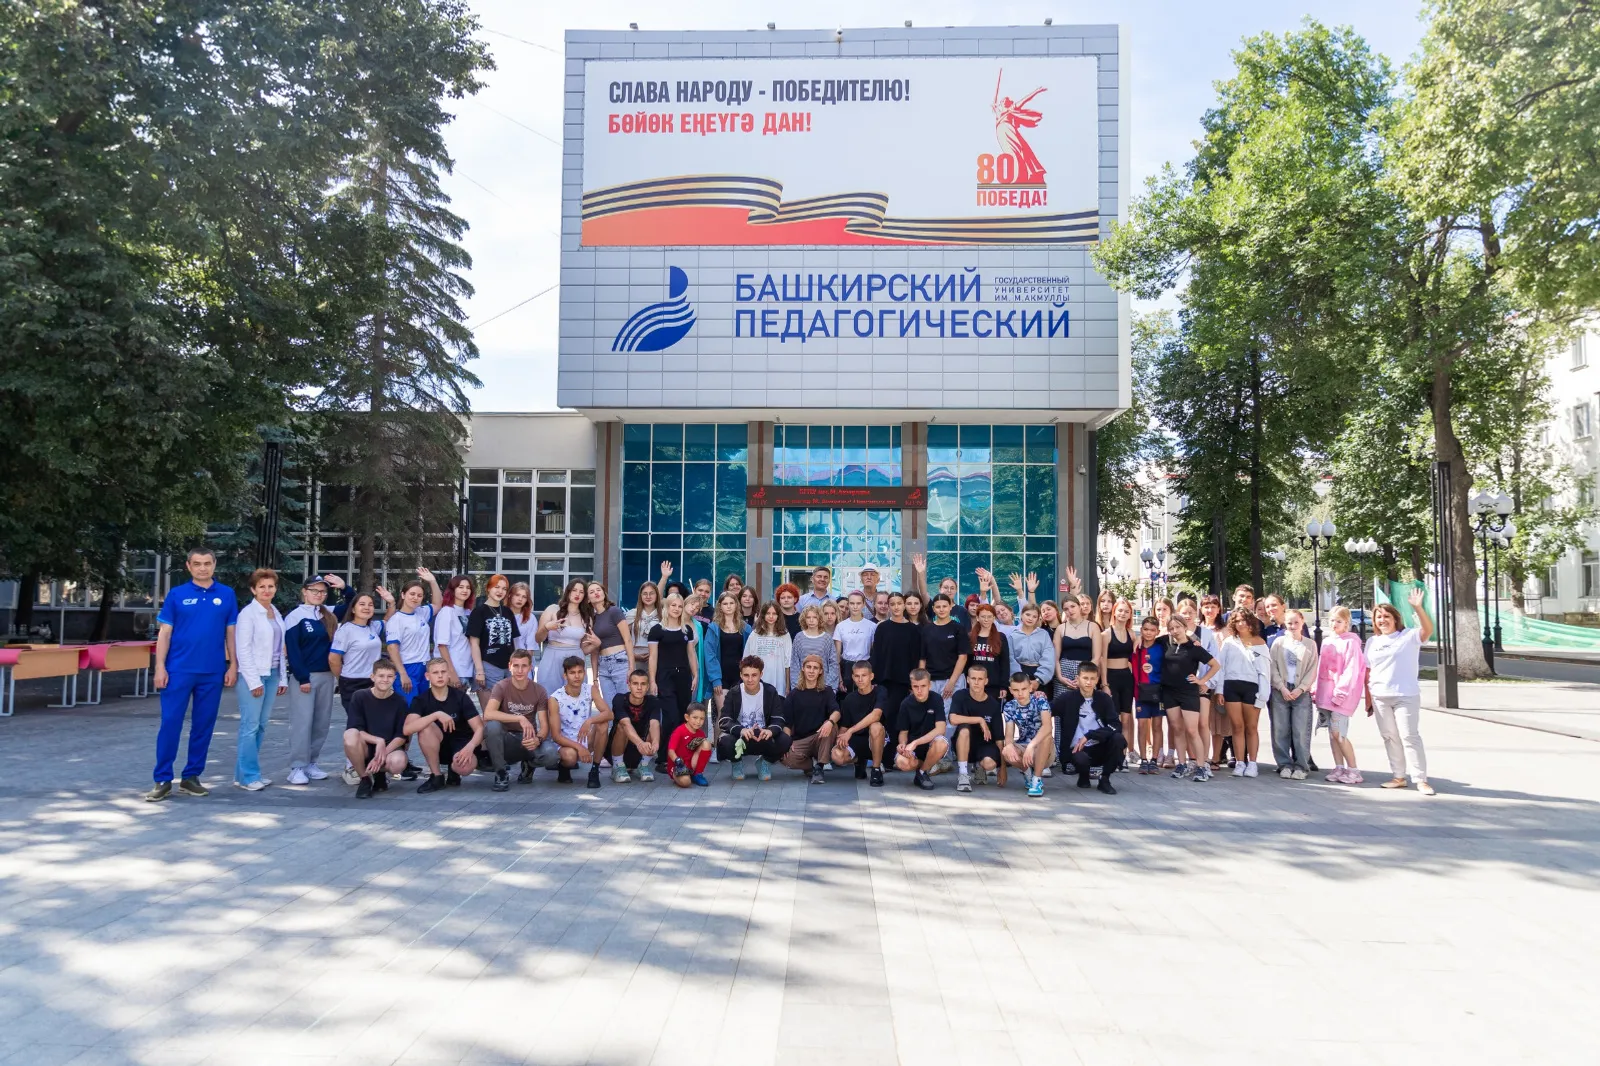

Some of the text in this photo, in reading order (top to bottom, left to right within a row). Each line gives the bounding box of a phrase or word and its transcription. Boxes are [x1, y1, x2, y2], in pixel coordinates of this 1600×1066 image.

[609, 81, 670, 103] СЛАВА
[676, 80, 753, 106] НАРОДУ
[772, 79, 910, 105] ПОБЕДИТЕЛЮ!
[608, 111, 674, 133] БӨЙӨК
[762, 112, 811, 135] ДАН!
[976, 153, 1015, 184] 80
[976, 190, 1047, 208] ПОБЕДА!
[735, 266, 981, 302] БАШКИРСКИЙ
[994, 276, 1070, 285] ГОСУДАРСТВЕННЫЙ
[994, 286, 1070, 294] УНИВЕРСИТЕТ
[735, 302, 1070, 343] ПЕДАГОГИЧЕСКИЙ
